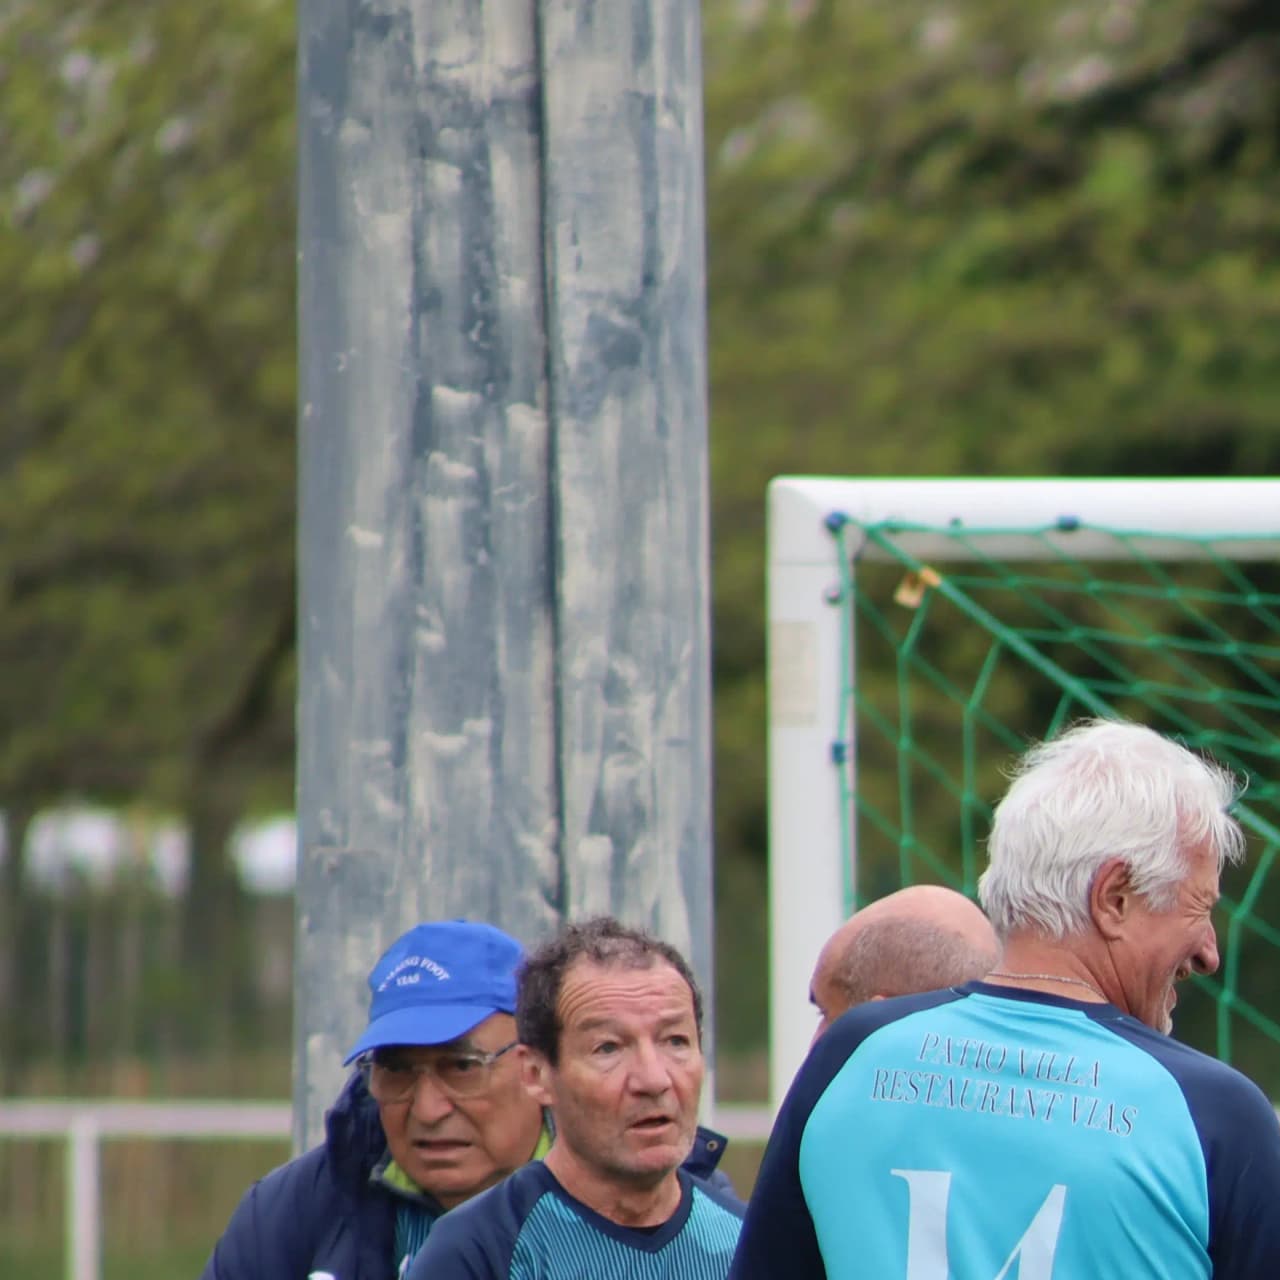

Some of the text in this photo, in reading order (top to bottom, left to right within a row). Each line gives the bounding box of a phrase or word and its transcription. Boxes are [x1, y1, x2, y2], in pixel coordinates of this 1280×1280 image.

[917, 1031, 1101, 1089] PATIO VILLA
[871, 1067, 1138, 1138] RESTAURANT VIAS
